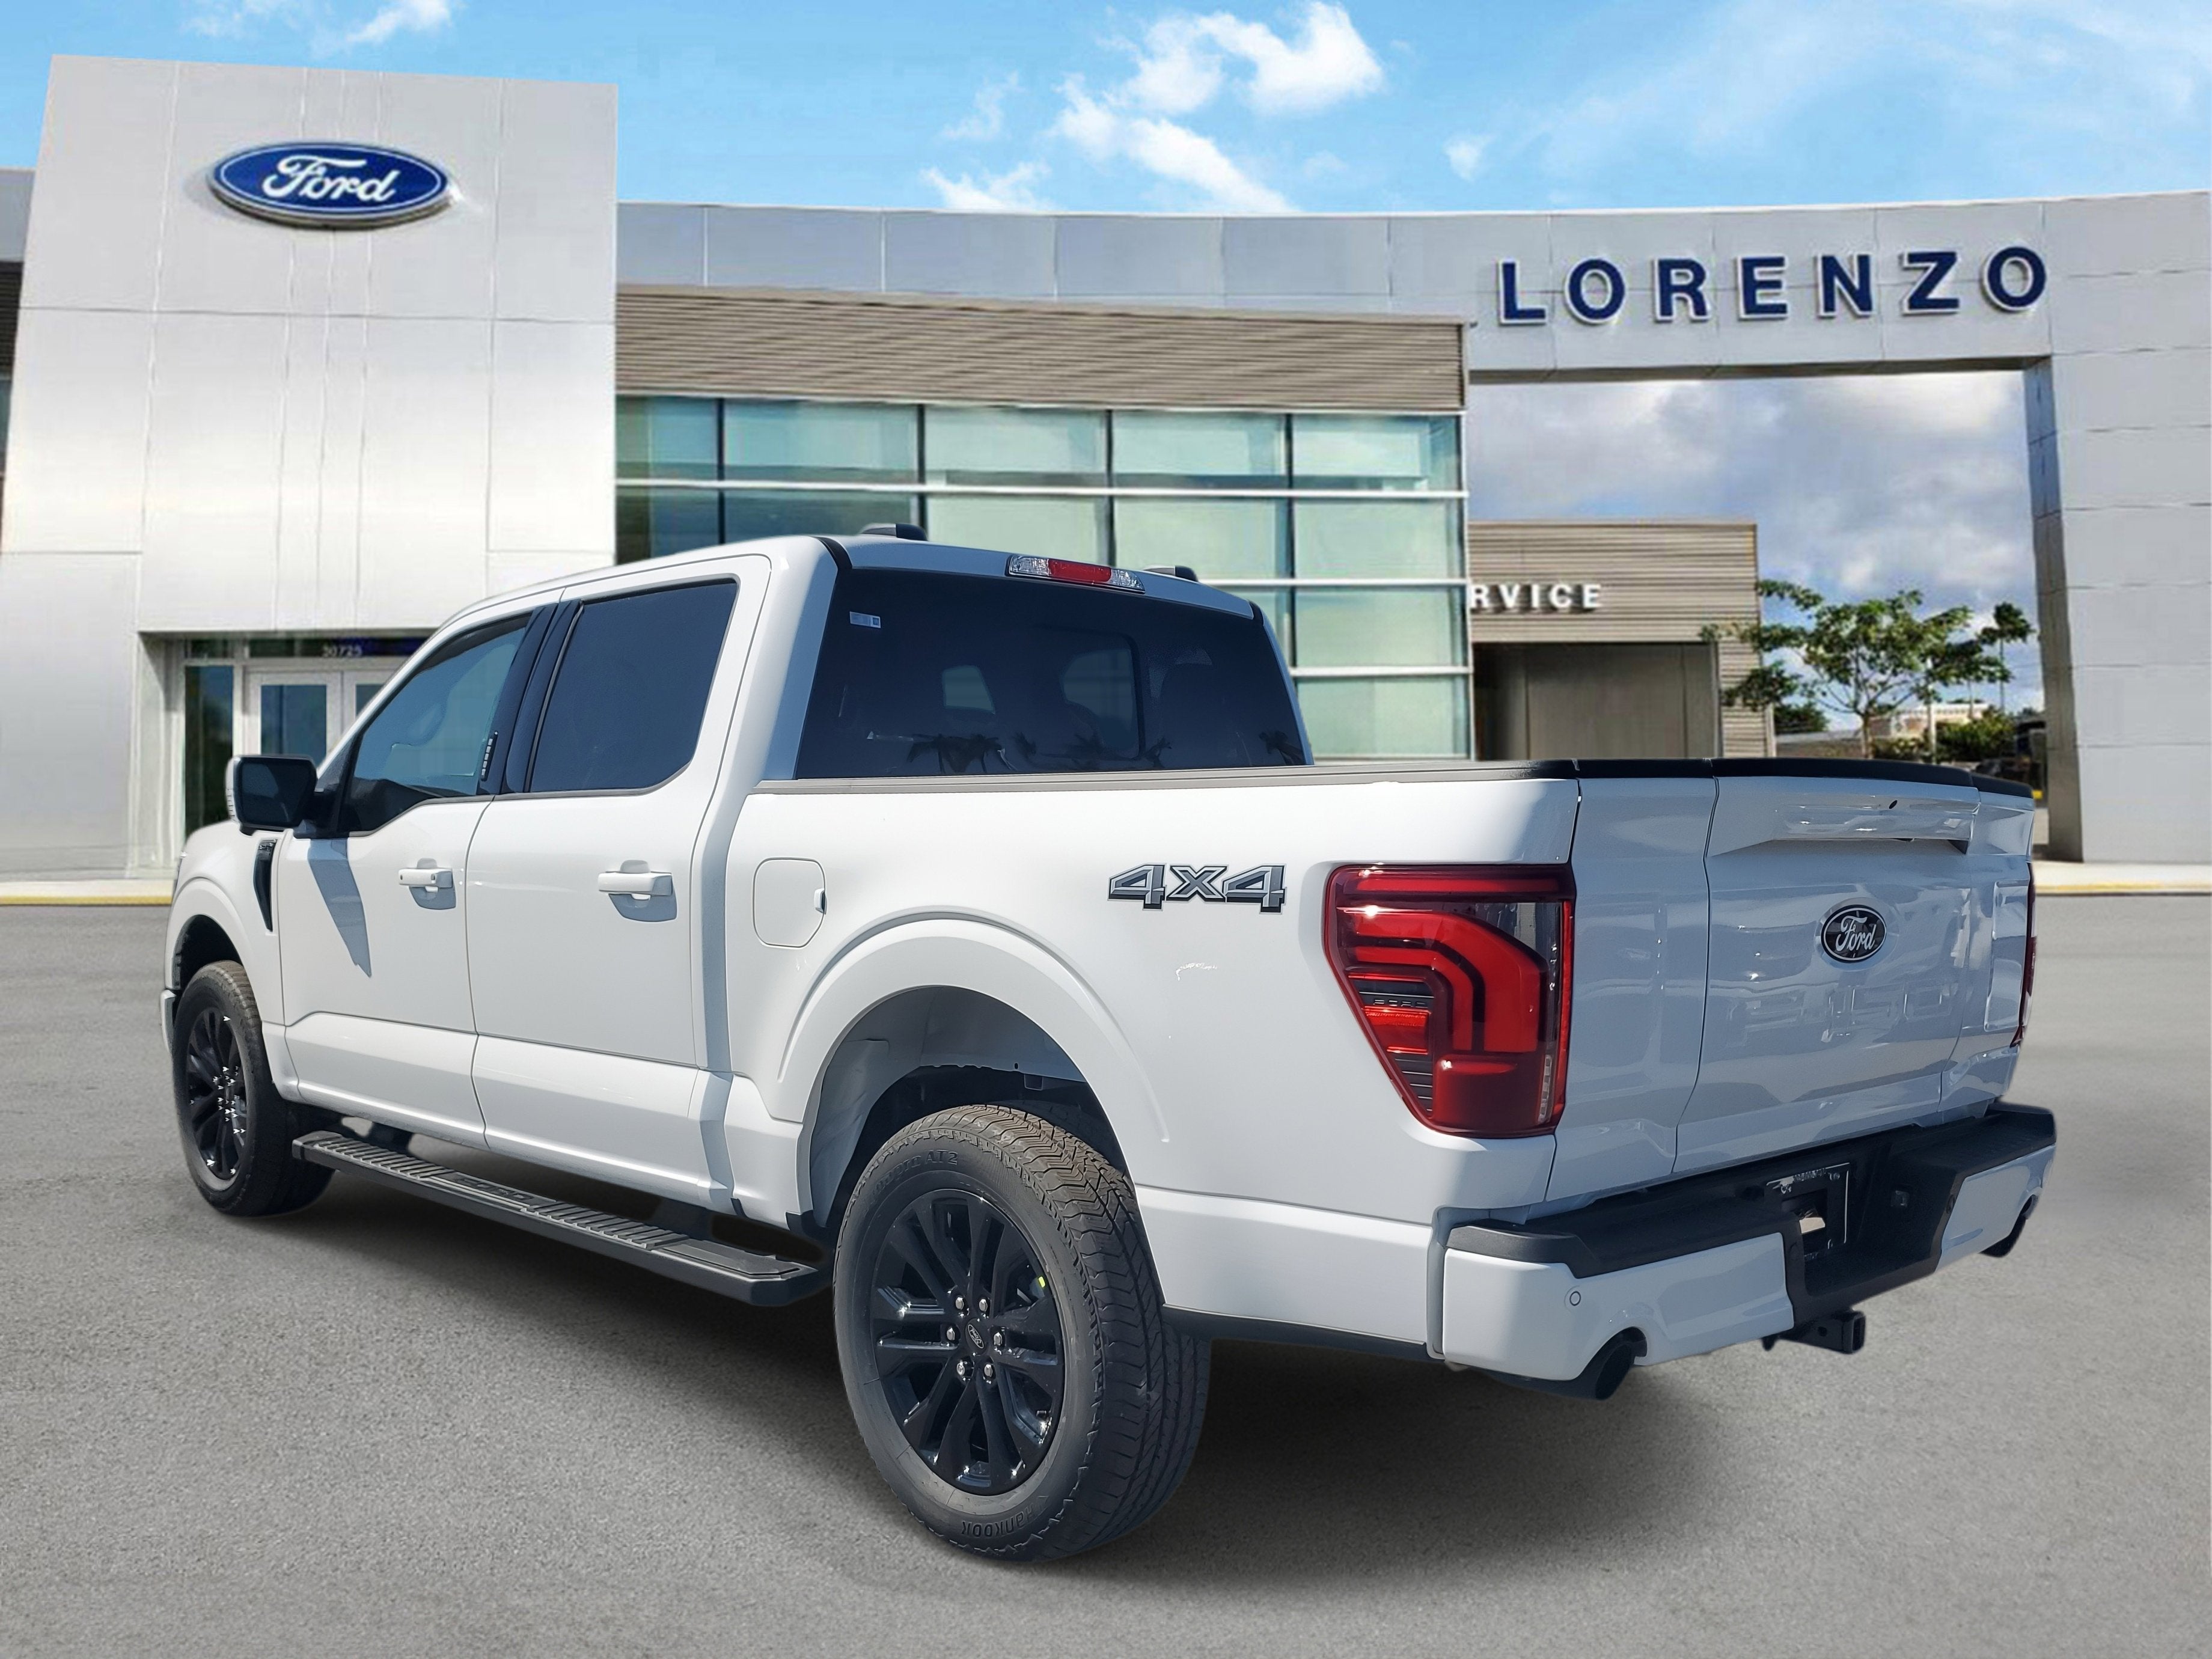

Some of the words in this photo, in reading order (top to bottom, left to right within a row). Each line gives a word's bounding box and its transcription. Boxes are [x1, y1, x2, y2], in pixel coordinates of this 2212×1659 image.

[262, 154, 402, 202] Ford
[1499, 246, 2047, 326] LORENZO
[1108, 863, 1287, 914] 4X4
[1835, 915, 1877, 952] Ford
